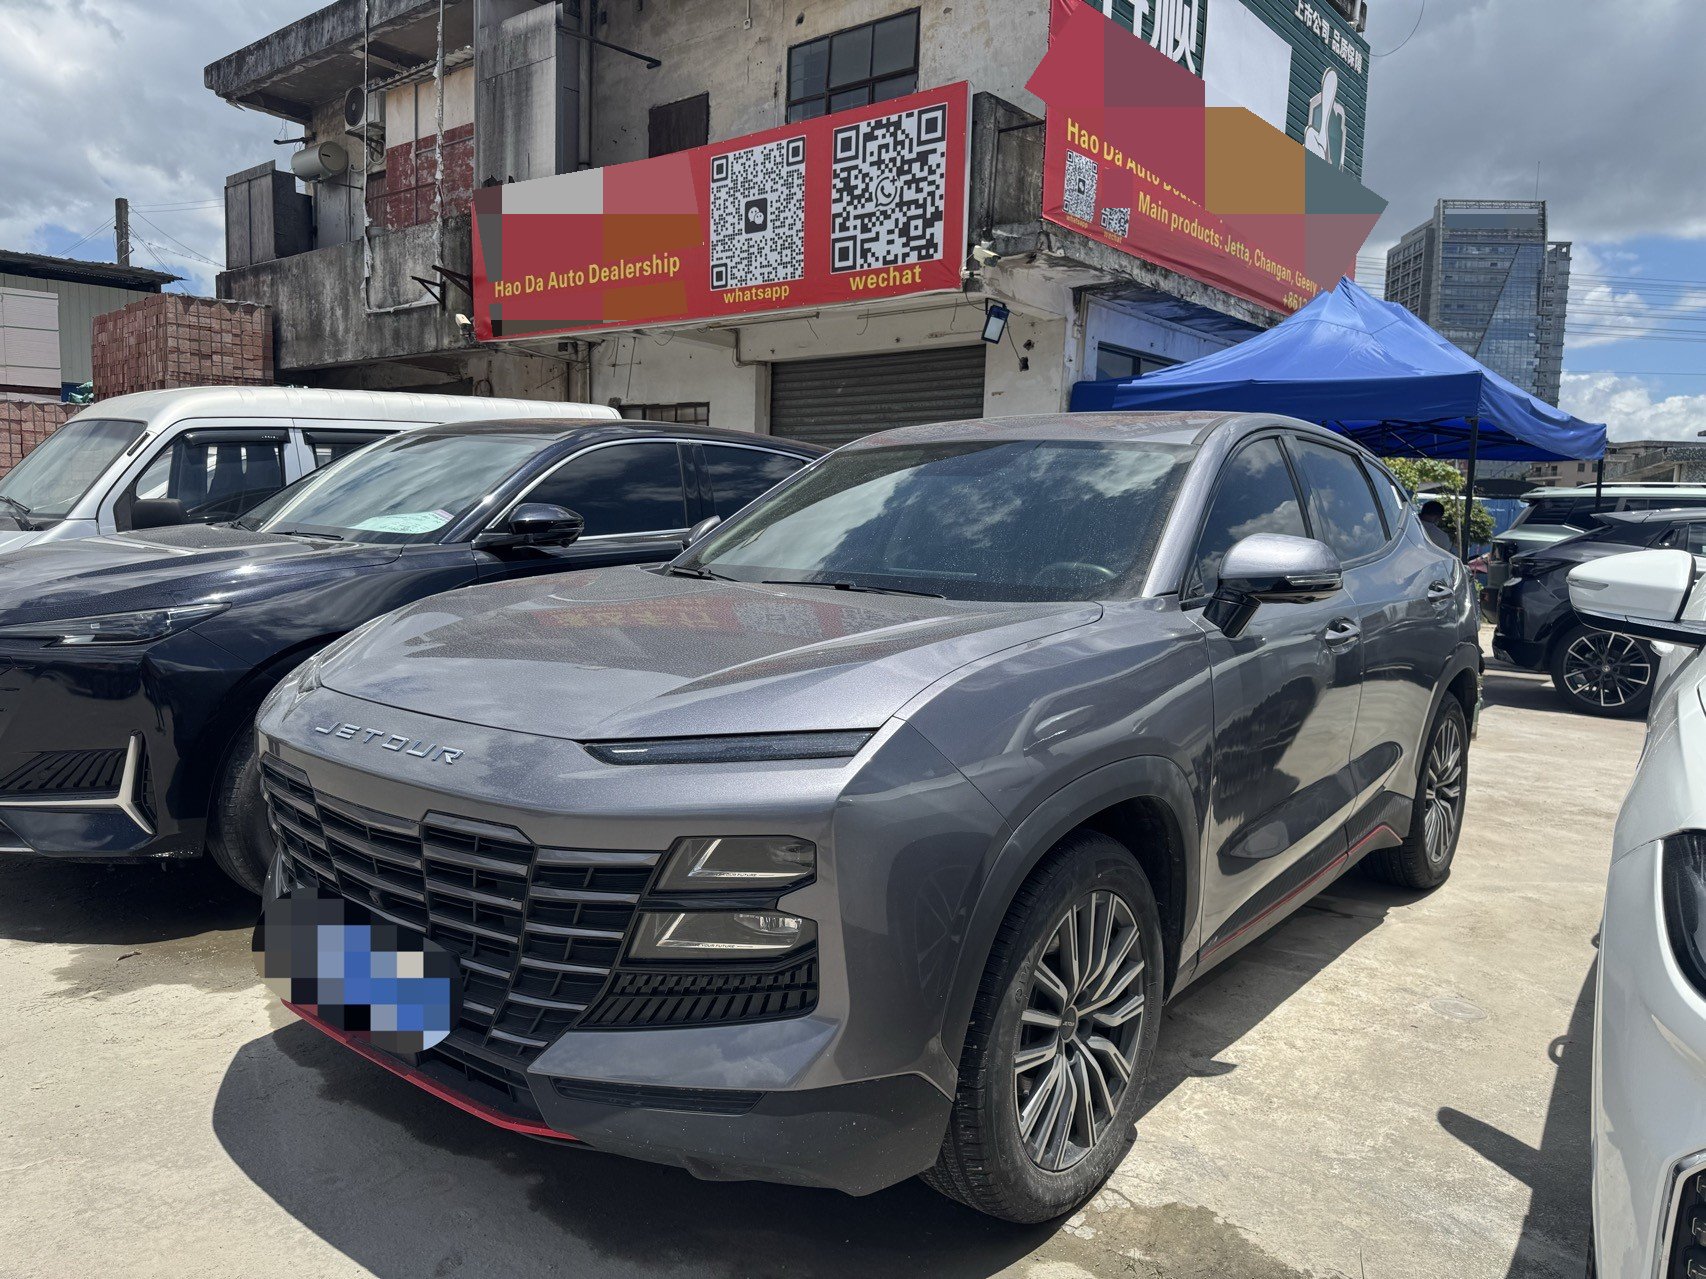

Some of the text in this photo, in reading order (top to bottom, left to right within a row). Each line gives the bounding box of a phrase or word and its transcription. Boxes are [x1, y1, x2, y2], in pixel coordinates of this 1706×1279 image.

[1294, 0, 1363, 75] 上市公司 品质保障
[1067, 117, 1100, 154] Hao
[1138, 190, 1169, 225] Main
[1170, 211, 1223, 250] products:
[1224, 234, 1253, 266] Jetta,
[1254, 248, 1294, 287] Changan,
[494, 252, 680, 298] Hao Da Auto Dealership
[723, 284, 790, 304] whatsapp
[849, 264, 922, 291] wechat
[314, 721, 466, 765] JETOUR
